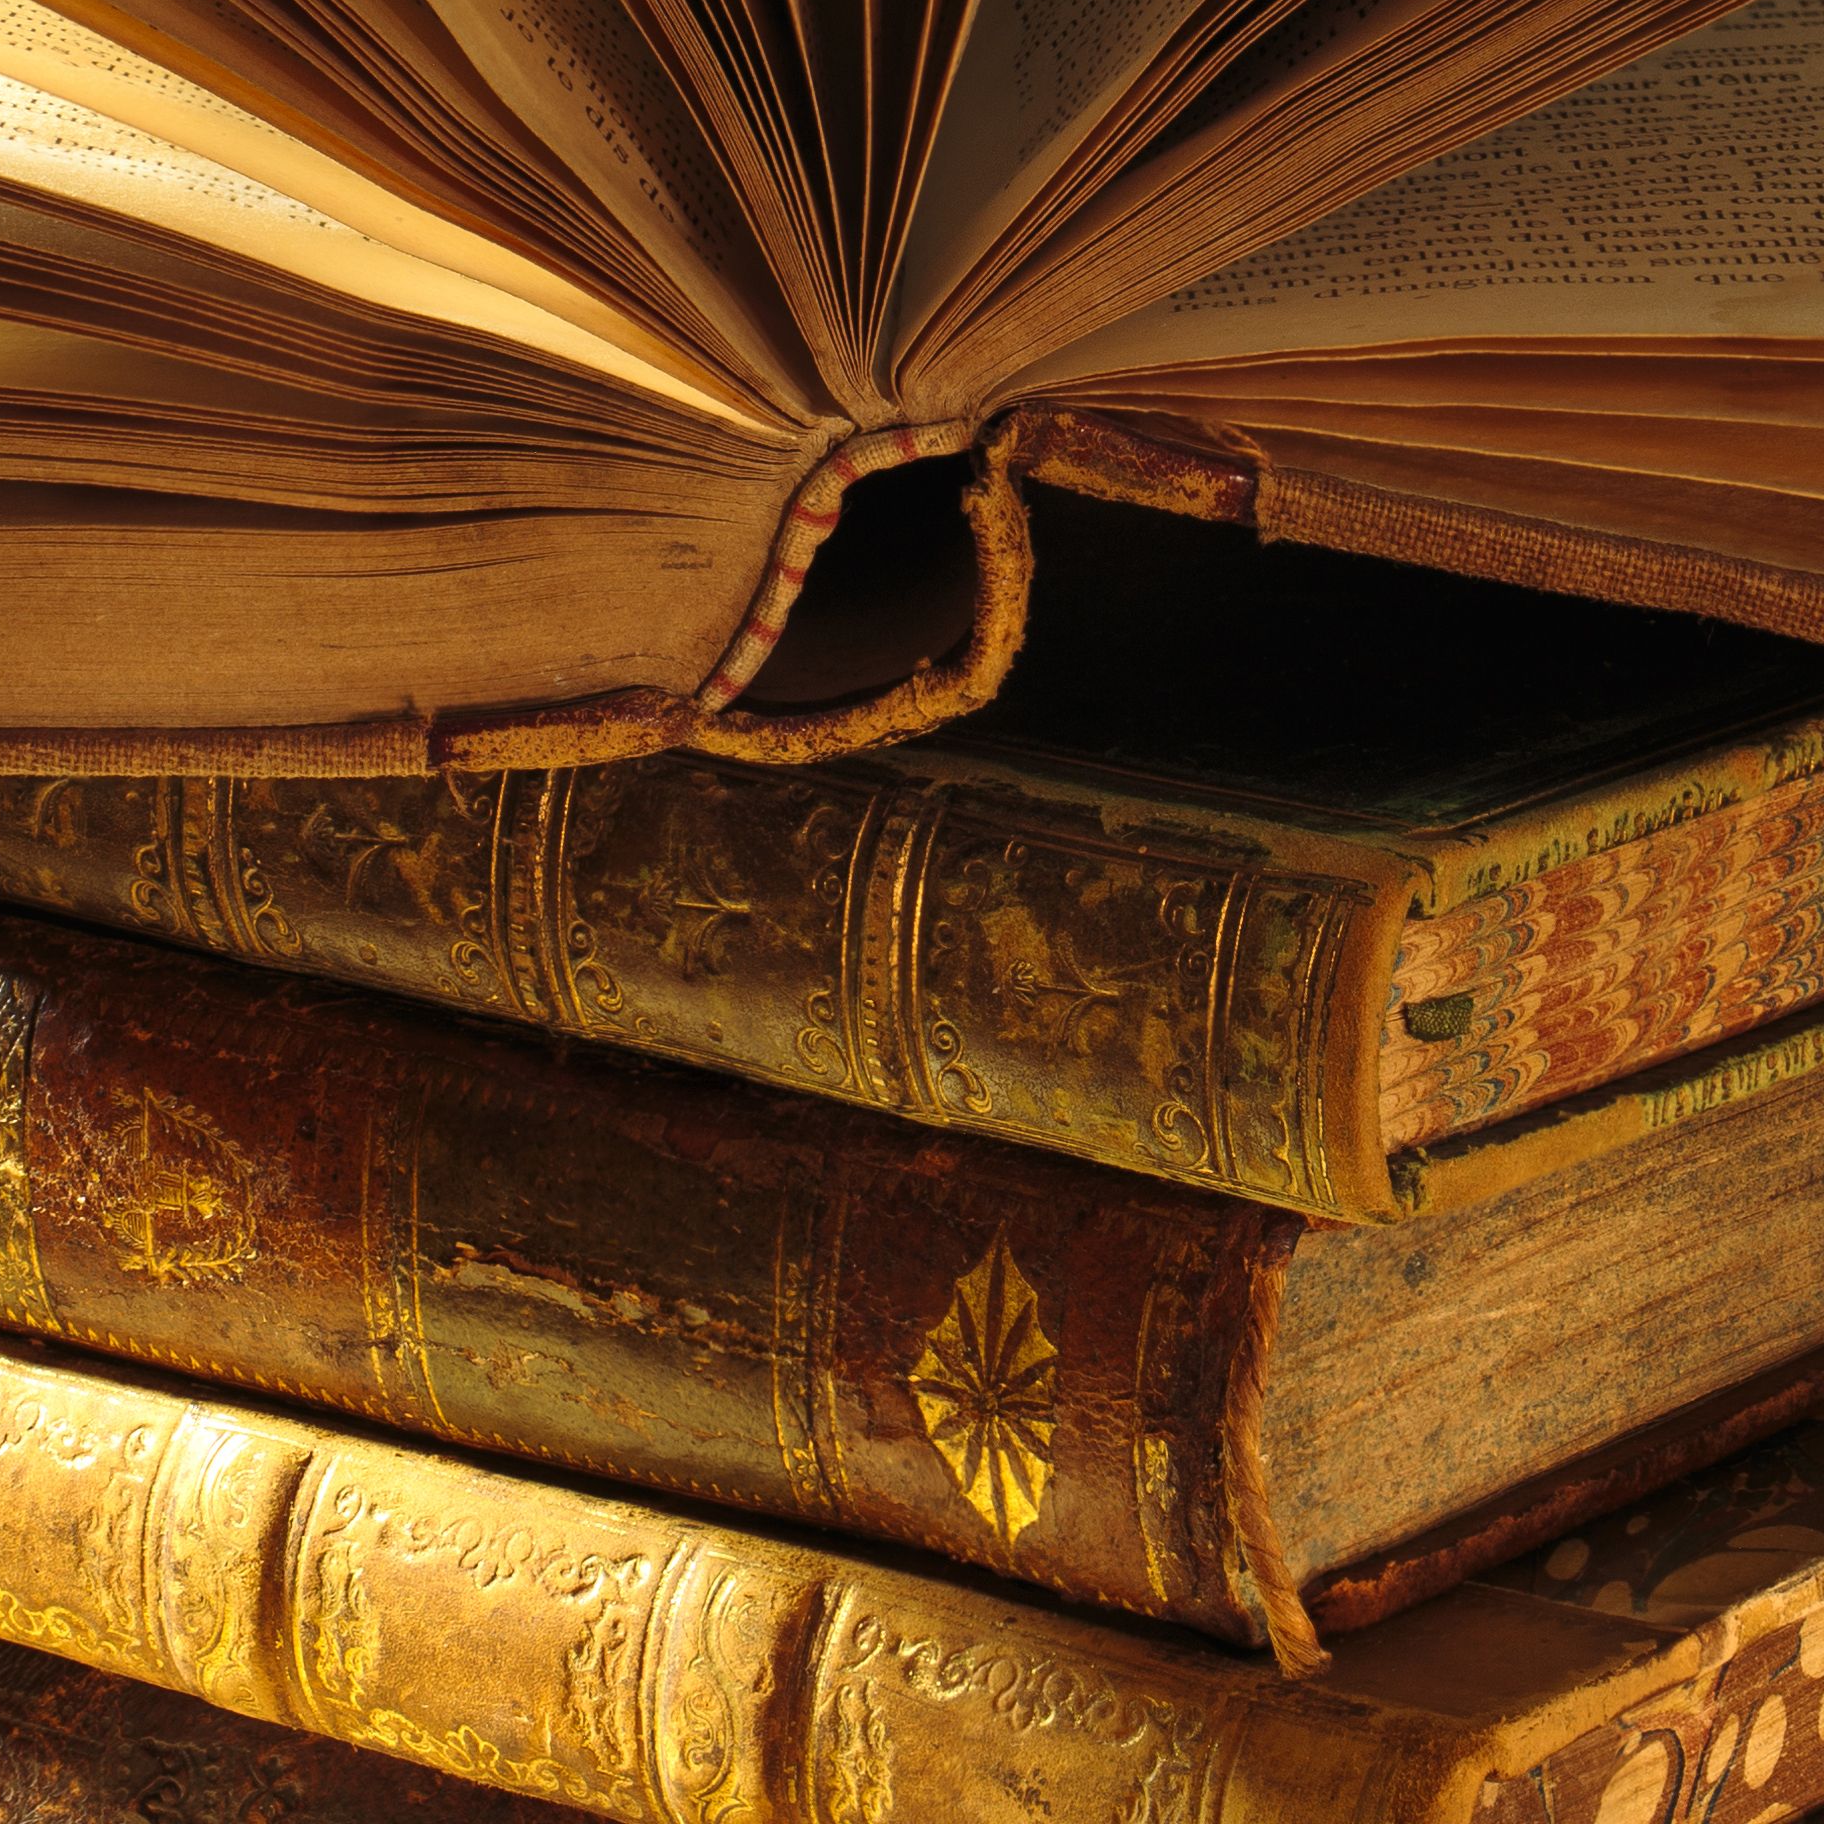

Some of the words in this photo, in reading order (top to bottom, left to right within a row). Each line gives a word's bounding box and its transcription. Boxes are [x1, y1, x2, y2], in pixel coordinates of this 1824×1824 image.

[1675, 72, 1802, 87] d'être
[1466, 180, 1520, 190] de
[1537, 169, 1646, 184] celle
[1660, 163, 1717, 172] de
[1500, 163, 1552, 176] de
[1569, 157, 1613, 170] la
[1509, 172, 1732, 196] m'occupe
[1510, 197, 1554, 208] je
[1628, 185, 1692, 196] les
[1700, 181, 1740, 192] ai
[1375, 208, 1540, 226] d'avoir
[1559, 198, 1708, 214] raison
[1435, 222, 1490, 232] de
[1509, 218, 1549, 229] le
[1563, 212, 1662, 225] leur
[1681, 209, 1792, 221] dire,
[1505, 232, 1569, 242] du
[1580, 224, 1724, 242] passé,
[1361, 247, 1505, 267] calme
[1531, 244, 1575, 255] et
[1166, 282, 1246, 300] qui
[1268, 267, 1407, 289] m'ont
[1422, 258, 1628, 274] toujours
[1648, 251, 1822, 267] semblé
[1170, 295, 1277, 313] frais
[1693, 273, 1786, 285] que
